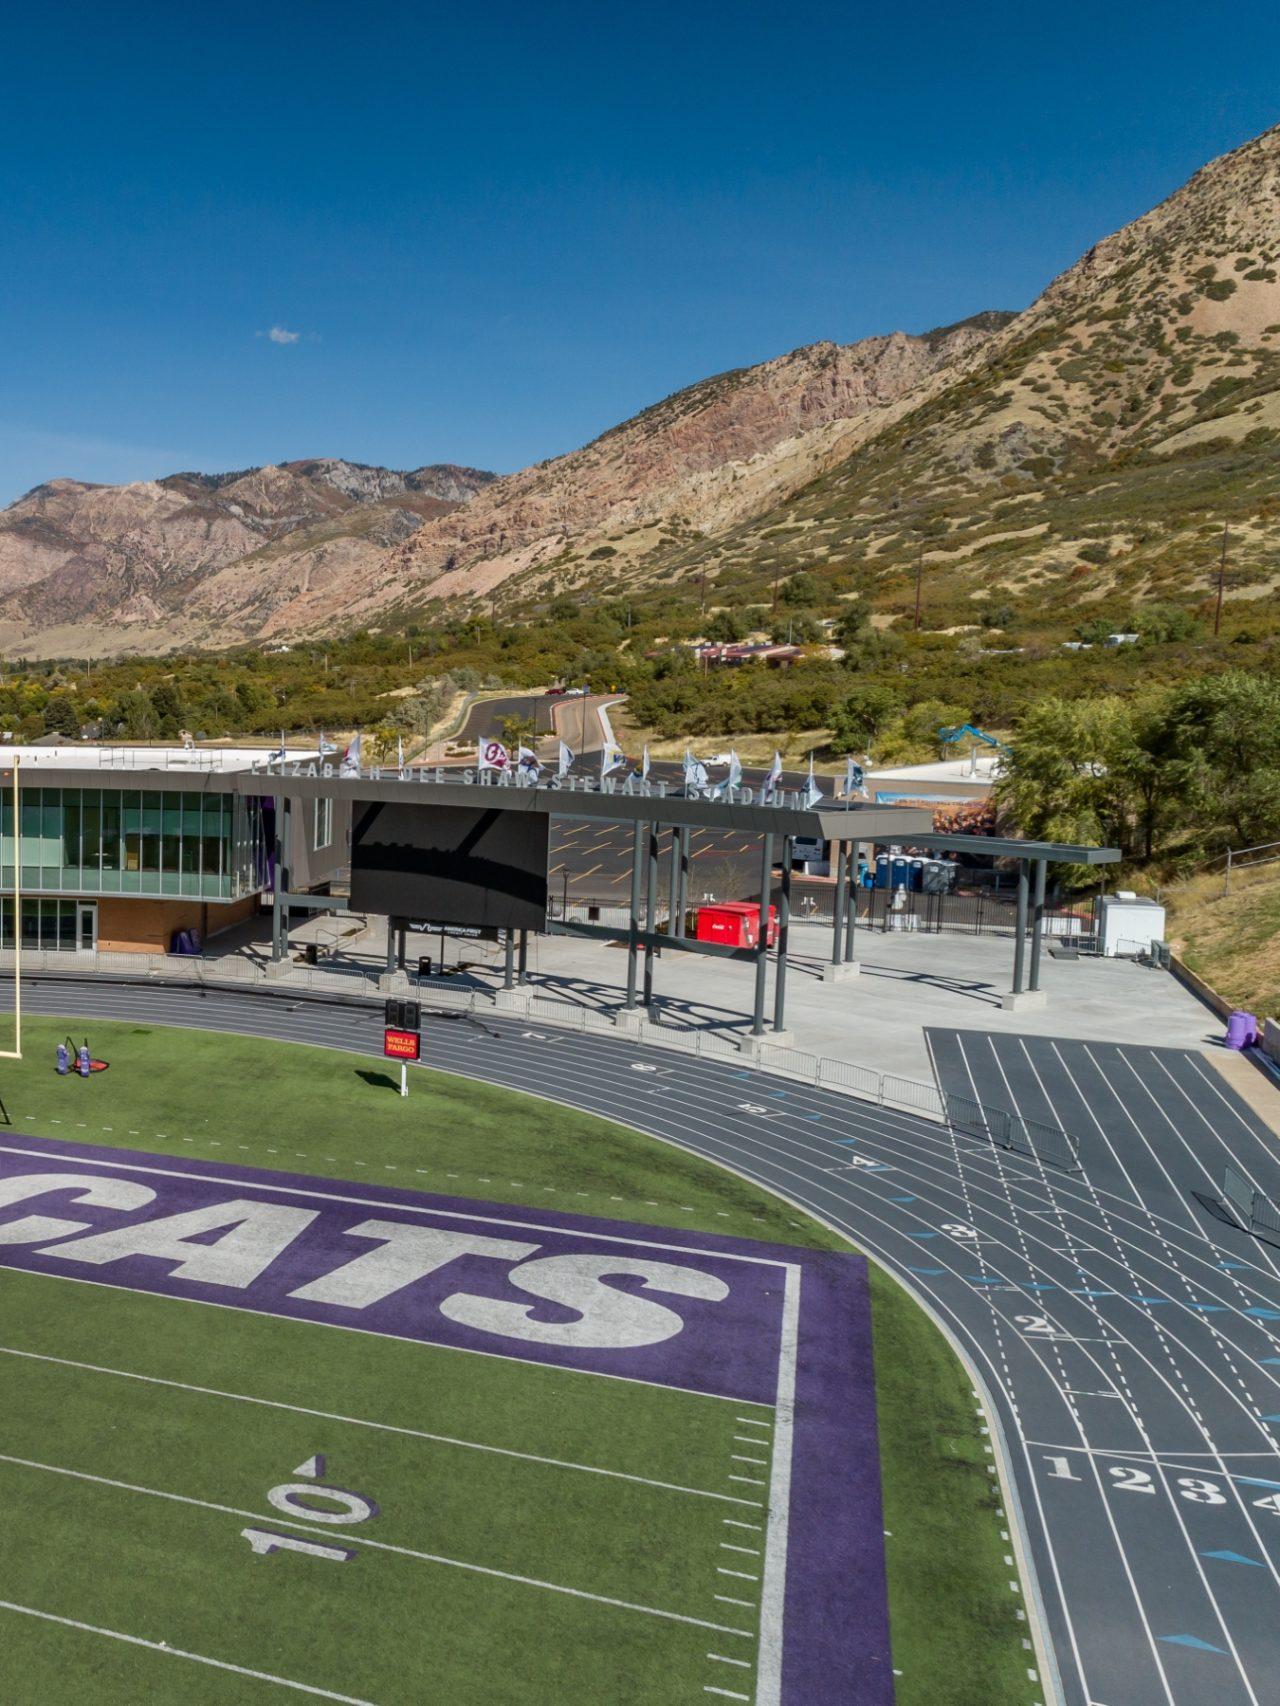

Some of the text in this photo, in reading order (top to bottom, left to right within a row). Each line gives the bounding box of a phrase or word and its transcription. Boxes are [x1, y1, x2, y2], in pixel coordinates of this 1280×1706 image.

[251, 760, 807, 811] ELIZABH DEE SHAW STEWART STADIUM
[387, 1036, 416, 1046] WELLS
[387, 1044, 415, 1053] FARGO
[941, 1222, 978, 1238] 3
[1014, 1314, 1055, 1334] 2
[1043, 1455, 1082, 1482] 1
[1109, 1466, 1157, 1495] 2
[1176, 1477, 1227, 1505] 3
